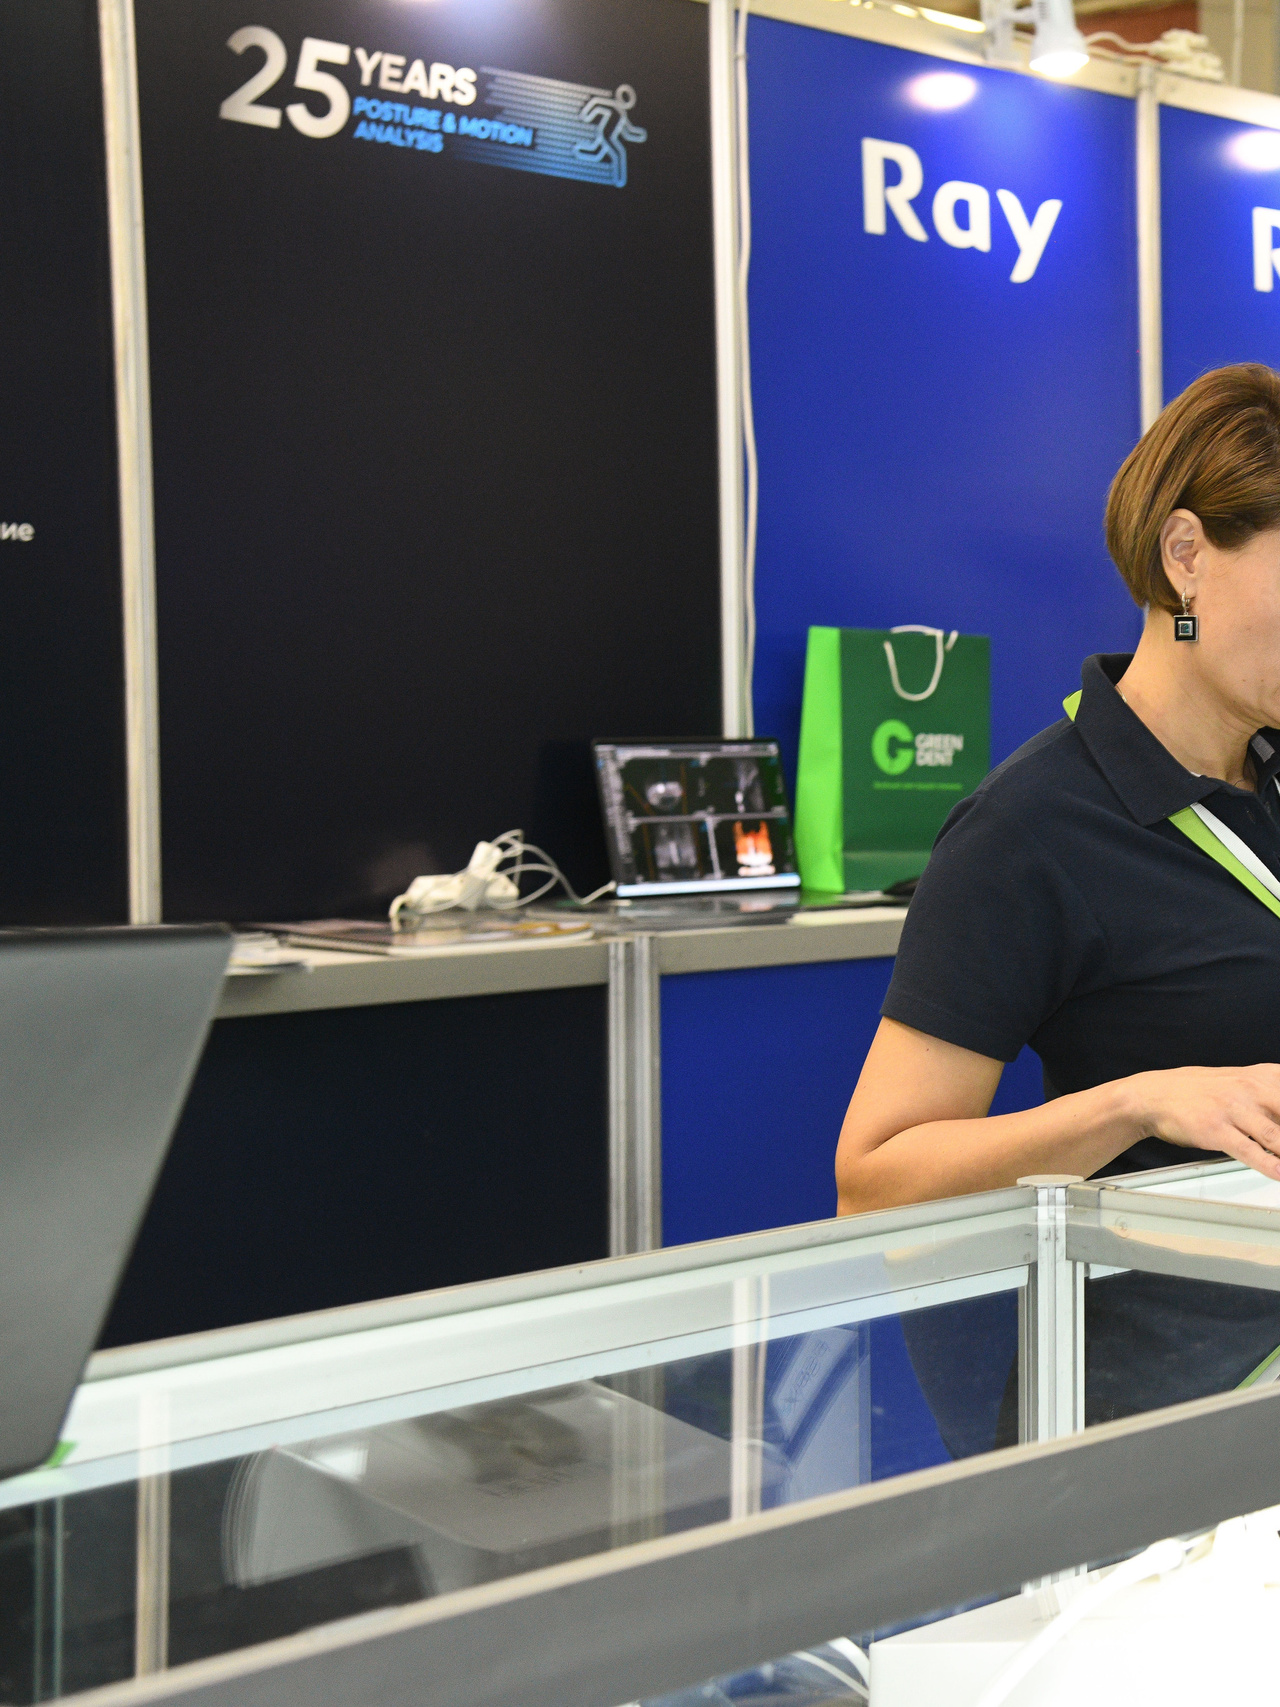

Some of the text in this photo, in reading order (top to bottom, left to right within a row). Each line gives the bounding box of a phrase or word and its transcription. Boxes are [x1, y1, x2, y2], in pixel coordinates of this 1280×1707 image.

[219, 25, 351, 138] 25
[354, 47, 478, 106] YEARS
[353, 96, 442, 131] POSTURE
[458, 115, 534, 147] MOTION
[353, 120, 444, 153] ANALYSIS
[861, 137, 1063, 284] Ray
